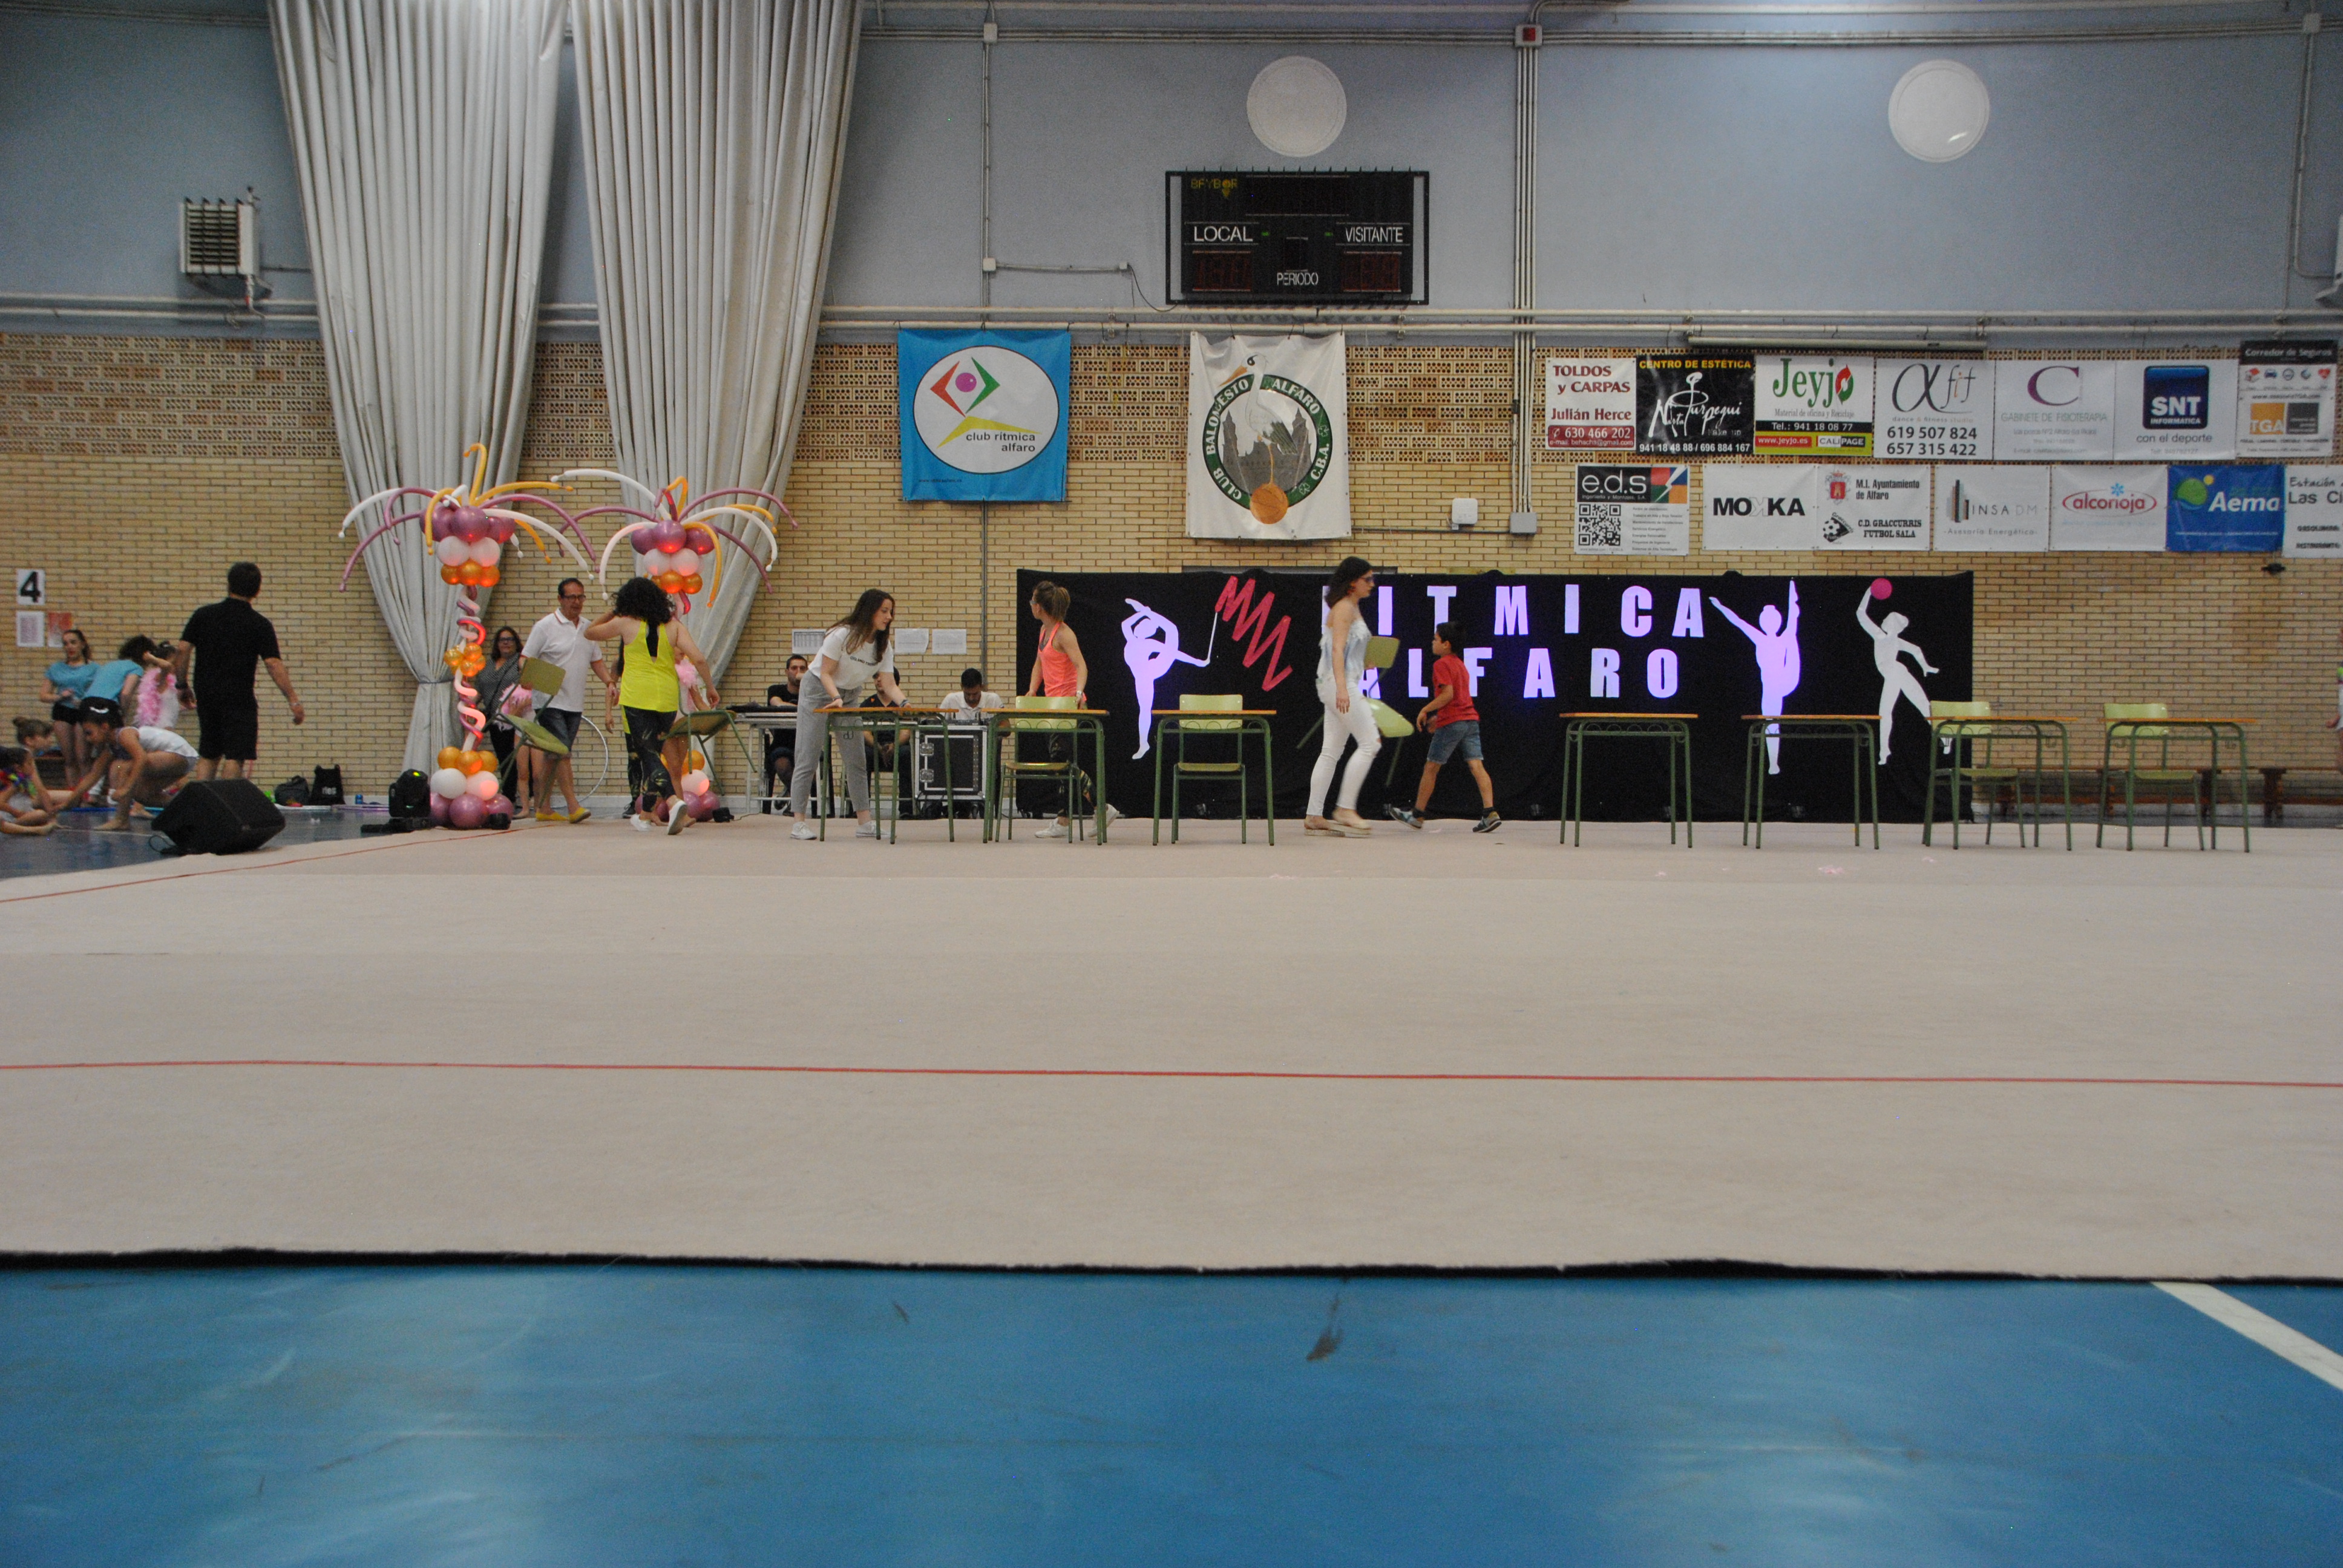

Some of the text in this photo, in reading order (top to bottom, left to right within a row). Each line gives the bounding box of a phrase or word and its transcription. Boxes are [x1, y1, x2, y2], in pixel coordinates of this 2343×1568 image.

[1194, 226, 1253, 242] LOCAL
[1345, 227, 1403, 243] VISITANTE
[1277, 272, 1319, 286] PERIODO
[1639, 360, 1682, 368] CENTRO
[1685, 360, 1699, 368] DE
[1553, 365, 1611, 377] TOLDOS
[1558, 382, 1631, 394] y CARPAS
[1772, 358, 1854, 408] Jeyjo
[2151, 396, 2201, 416] SNT
[1551, 408, 1631, 420] Julián Herce
[1774, 408, 1798, 417] Material
[1799, 408, 1806, 417] de
[1807, 409, 1824, 417] oficina
[1831, 409, 1855, 419] Reciclaje
[2001, 413, 2108, 422] GABINETE DE FISIOTERAPIA
[1772, 422, 1791, 431] Tel.:
[1794, 422, 1810, 431] 941
[1815, 422, 1824, 431] 18
[1828, 423, 1838, 431] 08
[2250, 419, 2284, 433] TGA
[966, 432, 1035, 441] club rítmica
[1565, 427, 1631, 438] 630 466 202
[1887, 426, 1977, 440] 619 507 824
[2159, 433, 2168, 443] el
[2171, 433, 2212, 444] deporte
[1213, 468, 1242, 500] CLUB
[1273, 379, 1320, 414] ALFARO
[1758, 436, 1808, 445] www.jeyjo.es
[1001, 443, 1035, 452] alfaro
[1639, 443, 1655, 452] 941
[1658, 443, 1668, 452] 18
[1670, 443, 1680, 452] 48
[1683, 443, 1693, 452] 88
[1700, 443, 1715, 452] 696
[1717, 443, 1733, 452] 884
[1735, 443, 1750, 452] 167
[1887, 443, 1976, 456] 657 315 422
[1582, 469, 1647, 494] e.d.s
[1873, 479, 1919, 490] Ayuntamiento
[2290, 476, 2335, 487] Estación
[1856, 491, 1889, 500] de Alfaro
[2209, 491, 2279, 512] Aema
[2289, 491, 2317, 504] Las
[1972, 505, 2037, 515] INSA DM
[1873, 519, 1922, 528] GRACCURRIS
[21, 571, 41, 603] 4
[1322, 584, 1704, 637] ITMICA
